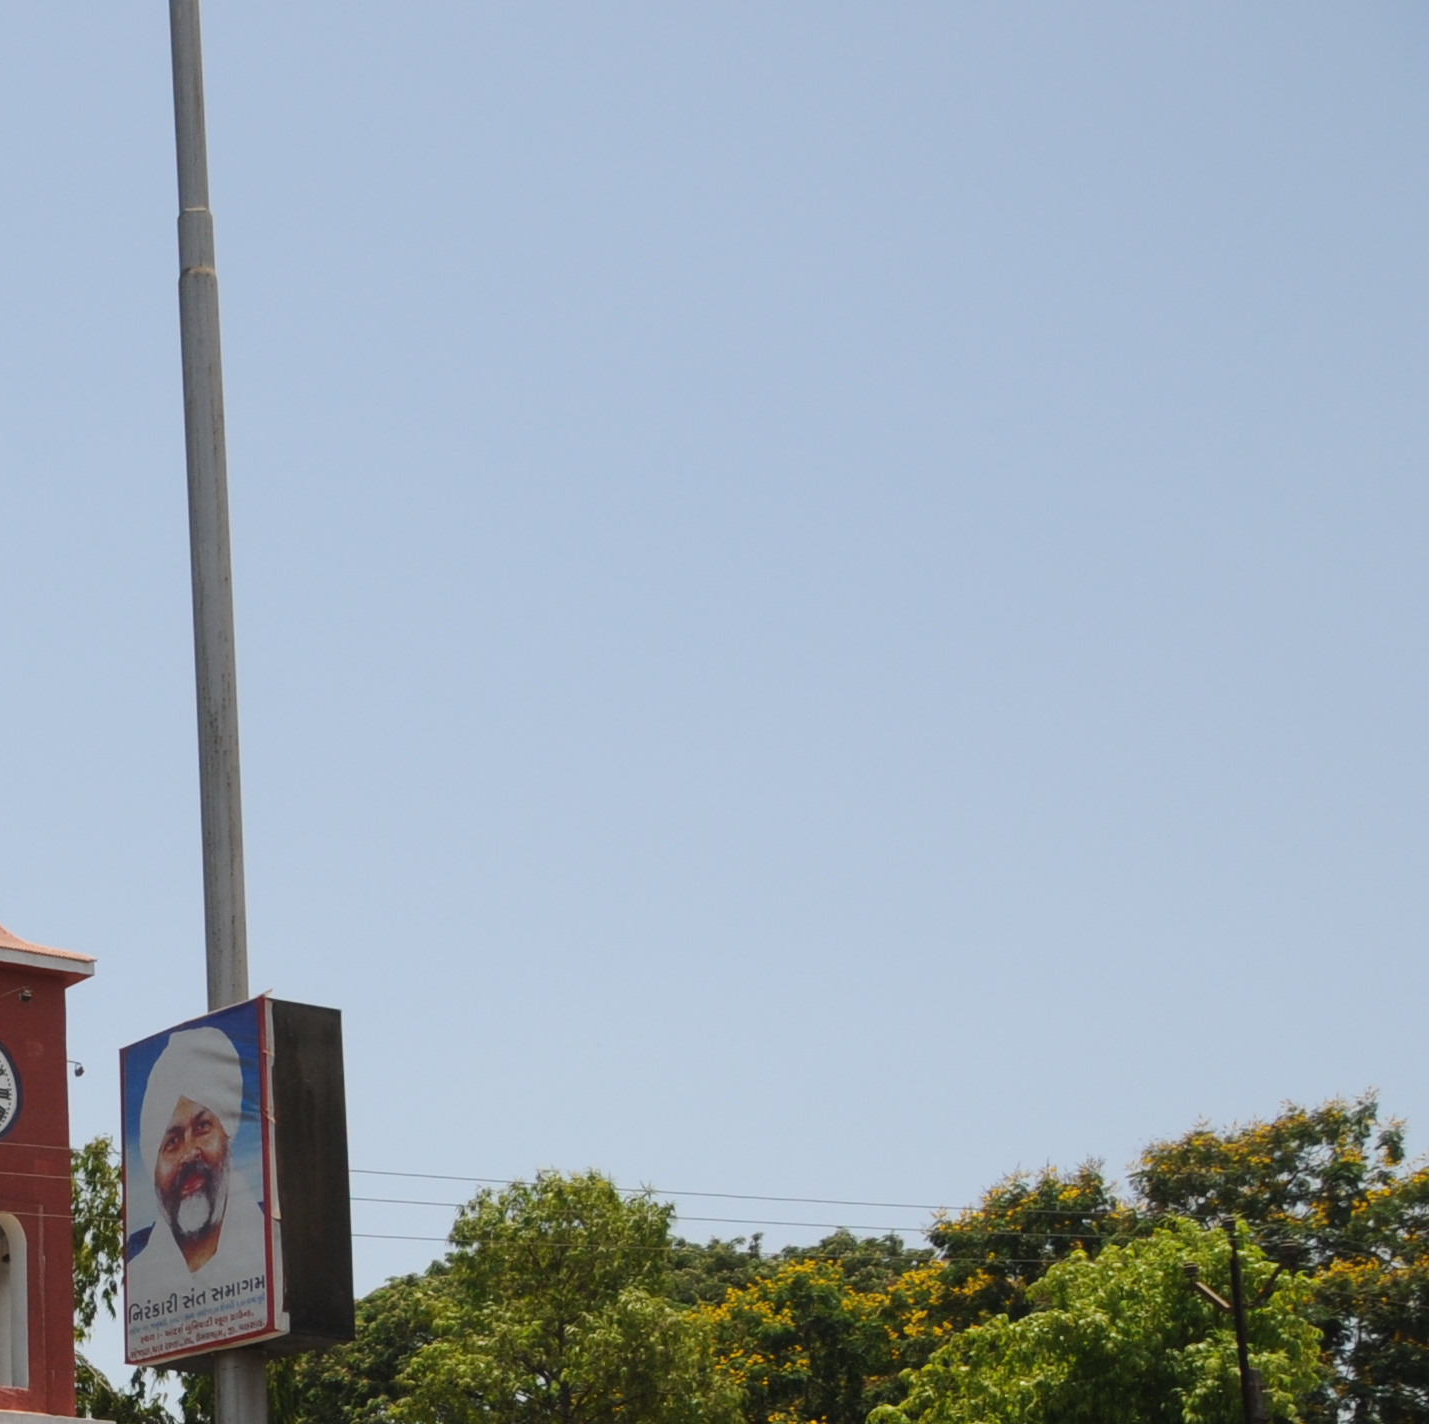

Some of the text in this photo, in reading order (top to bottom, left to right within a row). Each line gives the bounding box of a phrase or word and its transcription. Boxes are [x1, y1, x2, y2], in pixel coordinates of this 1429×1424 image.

[129, 1293, 178, 1324] નિરંકારી
[182, 1287, 206, 1309] સંત
[211, 1275, 266, 1302] સમાગમ
